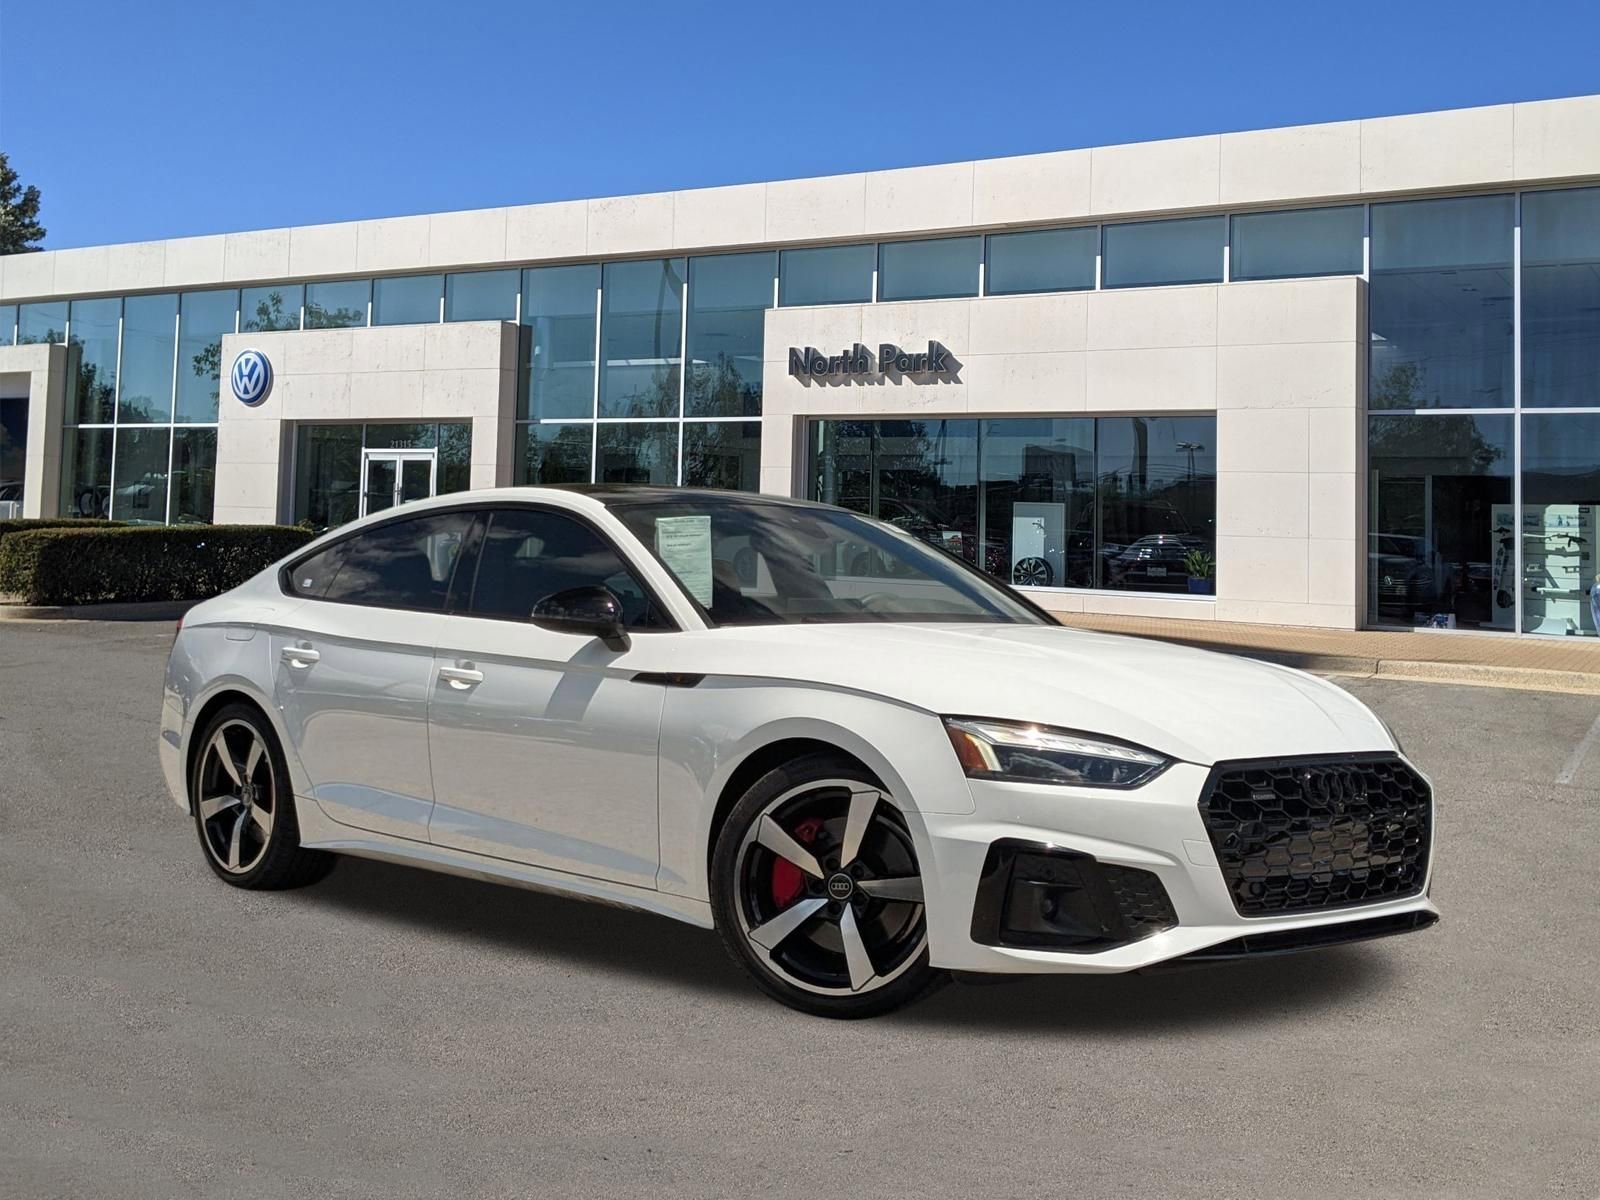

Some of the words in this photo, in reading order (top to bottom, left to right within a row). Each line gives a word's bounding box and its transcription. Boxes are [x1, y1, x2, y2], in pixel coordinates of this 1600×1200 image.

[233, 353, 264, 399] VW
[788, 343, 872, 376] North
[879, 340, 951, 373] Park
